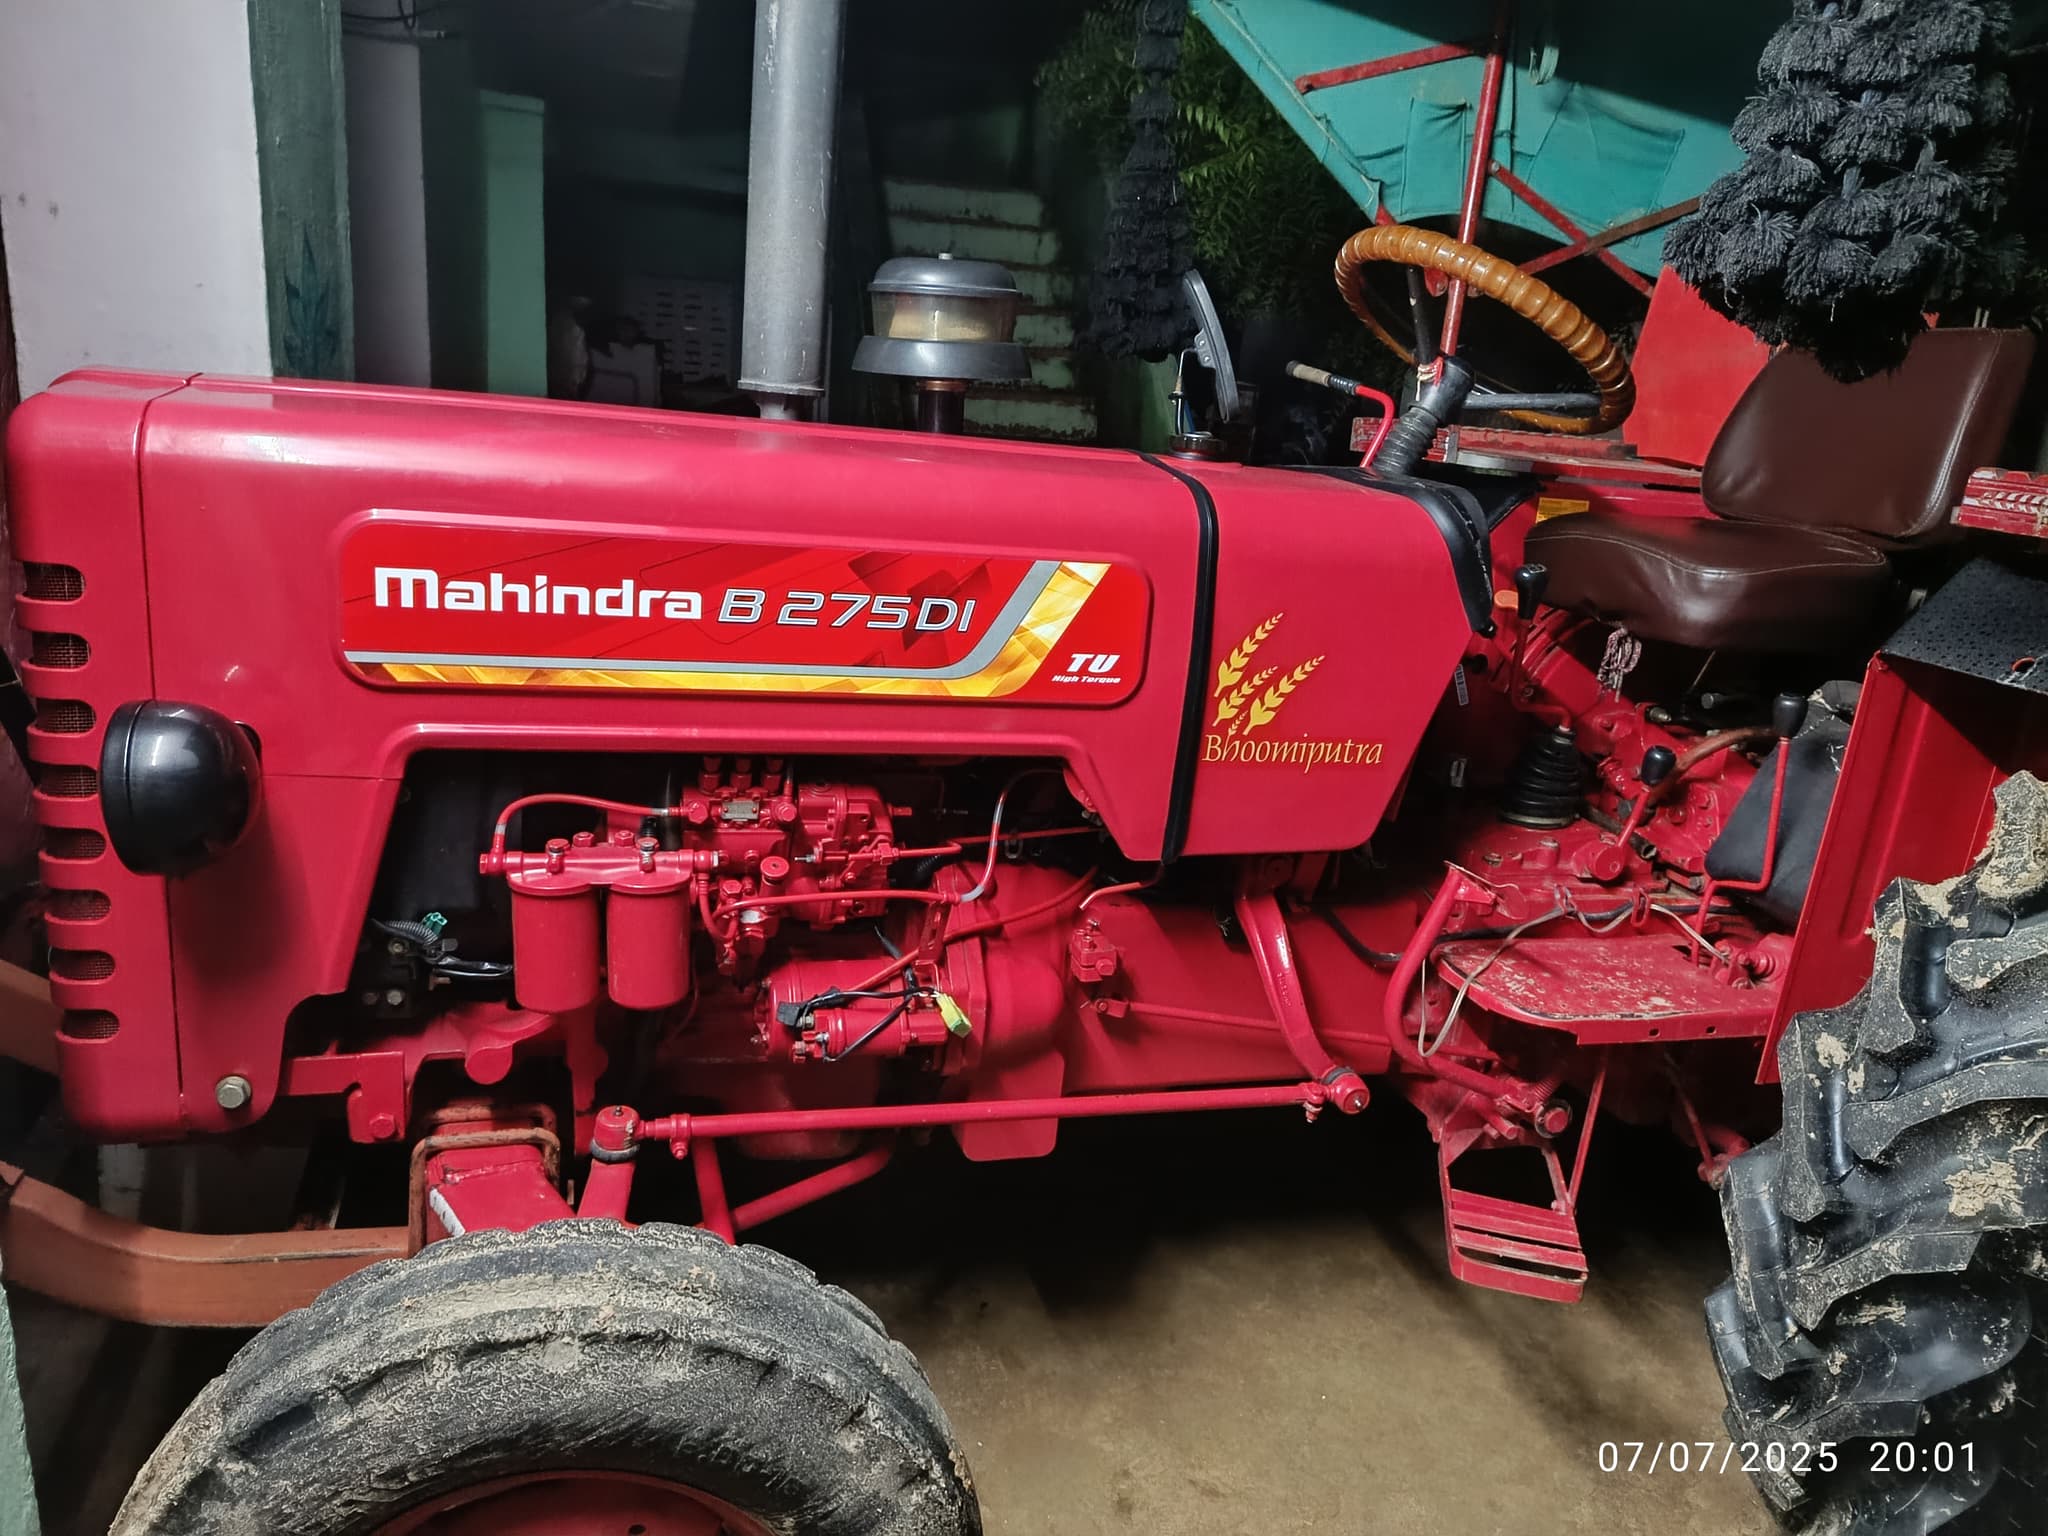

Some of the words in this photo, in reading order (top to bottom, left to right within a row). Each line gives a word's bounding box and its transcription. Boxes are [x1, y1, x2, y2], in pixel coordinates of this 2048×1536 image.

[374, 566, 703, 620] Mahindra
[717, 588, 767, 625] B
[1066, 653, 1121, 673] TU
[1051, 674, 1080, 683] High
[1080, 675, 1121, 684] Torque
[1202, 732, 1384, 774] Bhoomiputra
